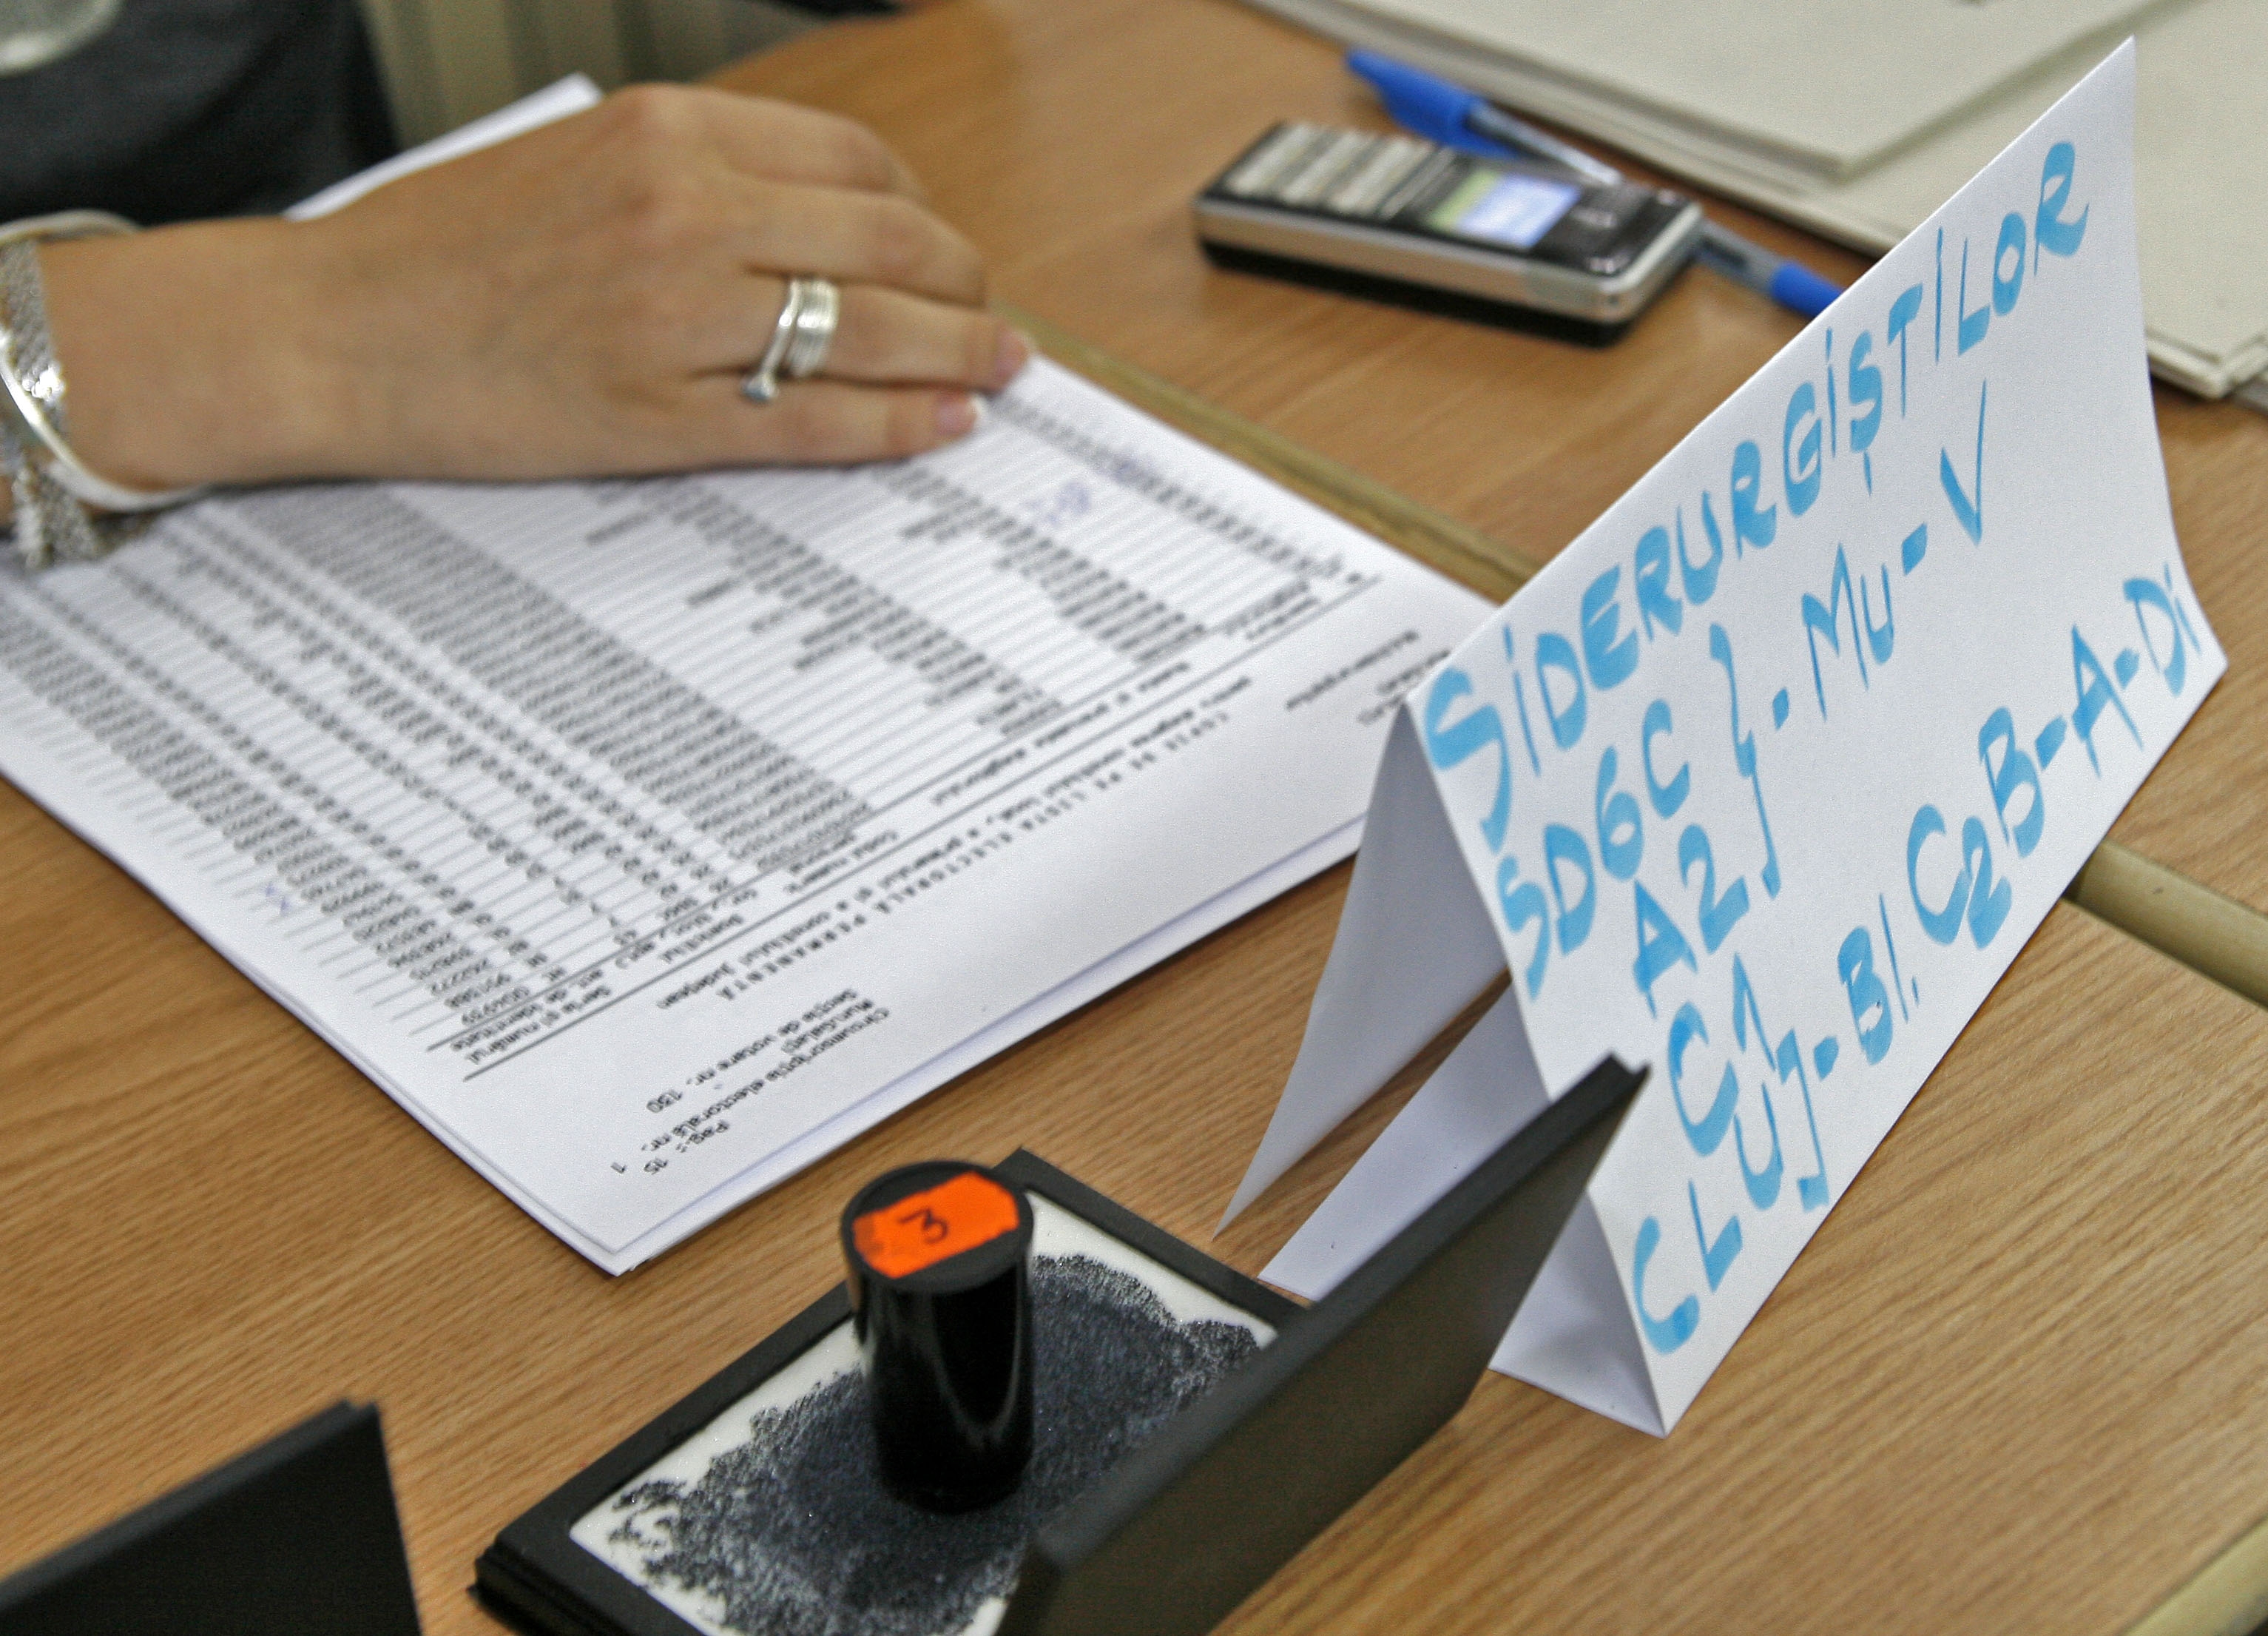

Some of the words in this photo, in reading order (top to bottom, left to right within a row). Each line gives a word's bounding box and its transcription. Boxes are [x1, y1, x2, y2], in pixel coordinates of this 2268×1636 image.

[1497, 699, 1691, 1000] SD6C
[1633, 823, 1750, 1017] A2
[642, 1086, 686, 1115] 130
[610, 1159, 630, 1175] 1
[639, 1154, 672, 1176] 15
